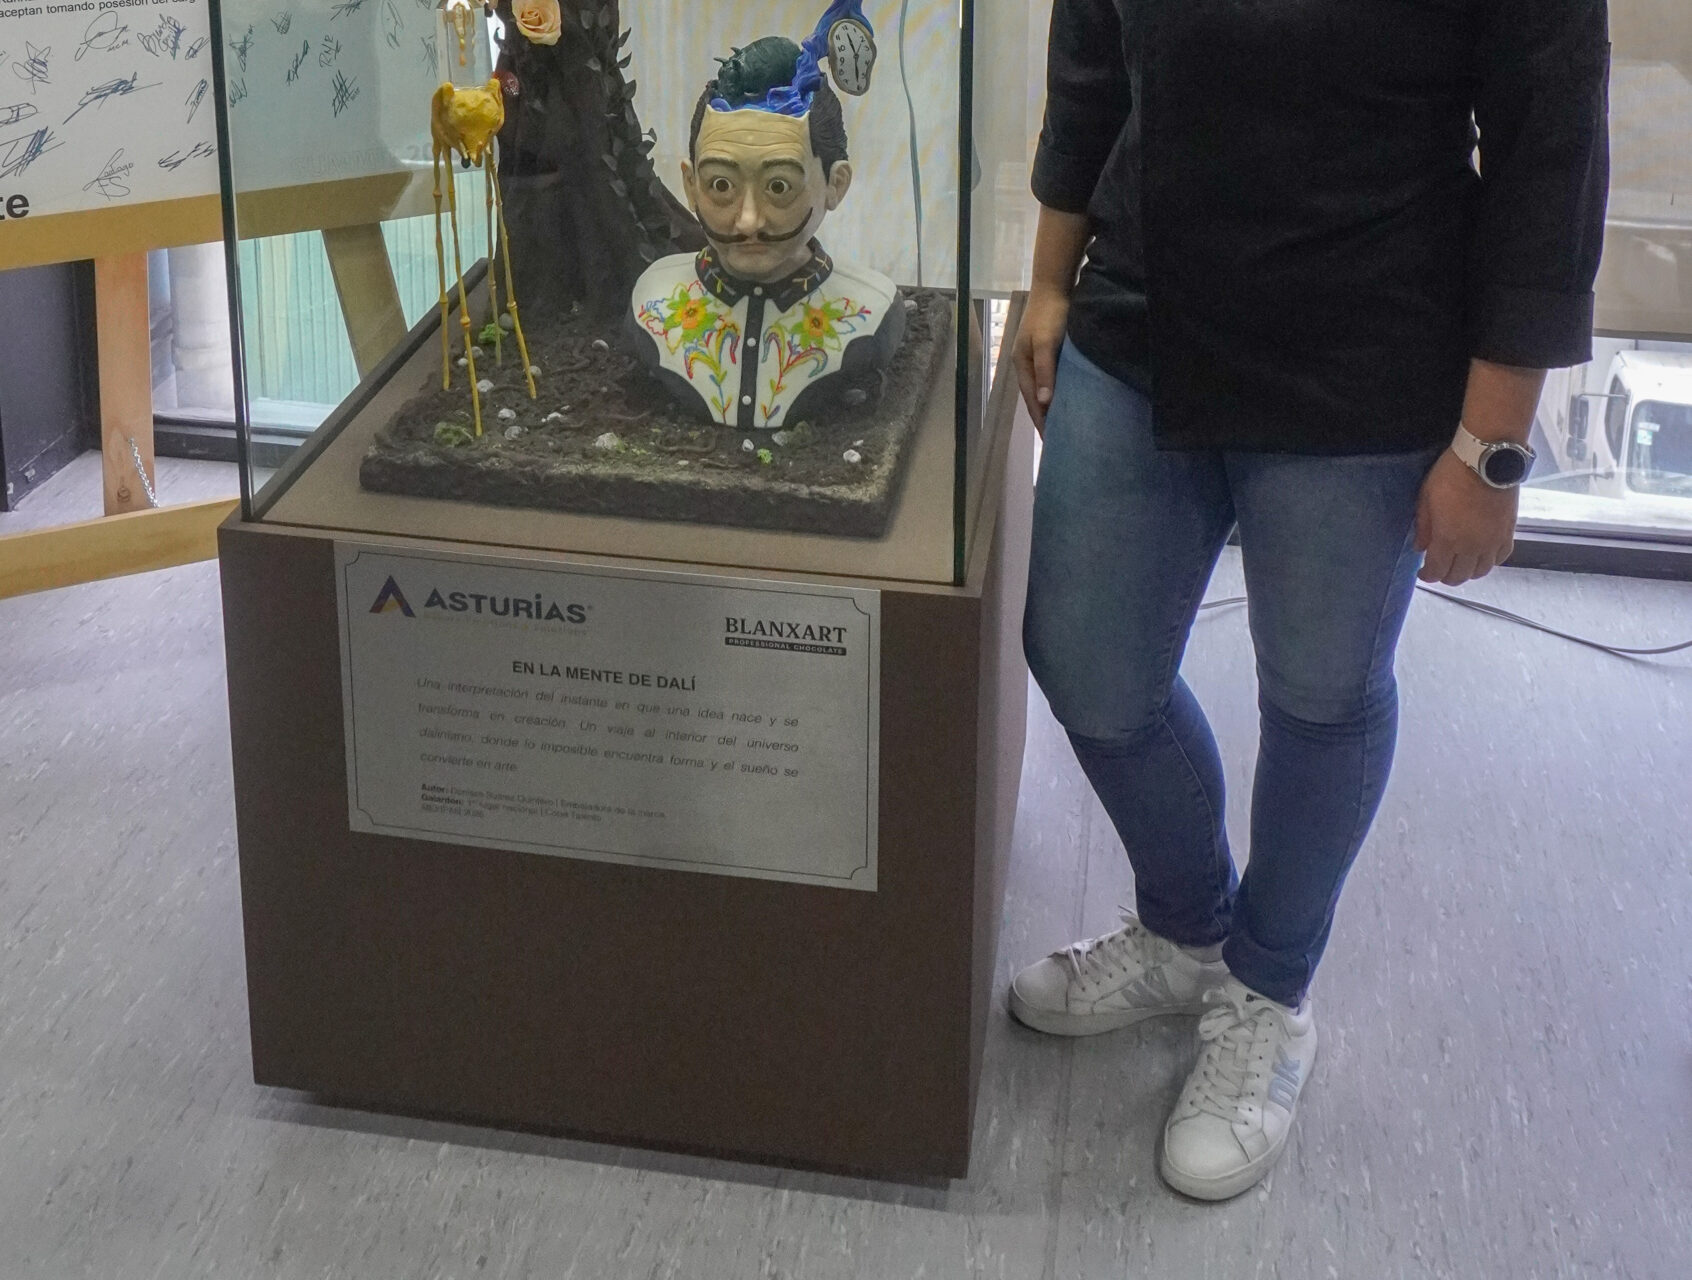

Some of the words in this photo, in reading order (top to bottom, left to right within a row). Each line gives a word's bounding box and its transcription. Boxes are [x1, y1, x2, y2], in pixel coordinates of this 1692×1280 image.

[47, 1, 94, 14] tomando
[725, 616, 847, 643] BLANXART
[728, 638, 790, 650] PROFESSIONAL
[512, 661, 534, 675] EN
[540, 664, 561, 677] LA
[566, 666, 623, 684] MENTE
[629, 672, 652, 687] DE
[657, 675, 696, 691] DALÍ
[417, 678, 440, 690] Una
[448, 682, 528, 699] interpretación
[536, 691, 554, 703] del
[637, 704, 660, 715] que
[698, 708, 723, 720] idea
[731, 712, 762, 723] nace
[769, 717, 777, 727] y
[784, 717, 799, 727] se
[418, 703, 479, 719] transforma
[580, 720, 597, 731] Un
[644, 727, 655, 738] al
[717, 735, 736, 746] del
[747, 737, 799, 753] universo
[420, 753, 473, 767] convierte
[481, 734, 519, 748] donde
[525, 739, 535, 750] lo
[541, 741, 598, 757] imposible
[603, 749, 664, 764] encuentra
[670, 756, 704, 768] forma
[710, 761, 718, 771] y
[723, 760, 734, 770] el
[741, 762, 777, 775] sueño
[783, 767, 799, 777] se
